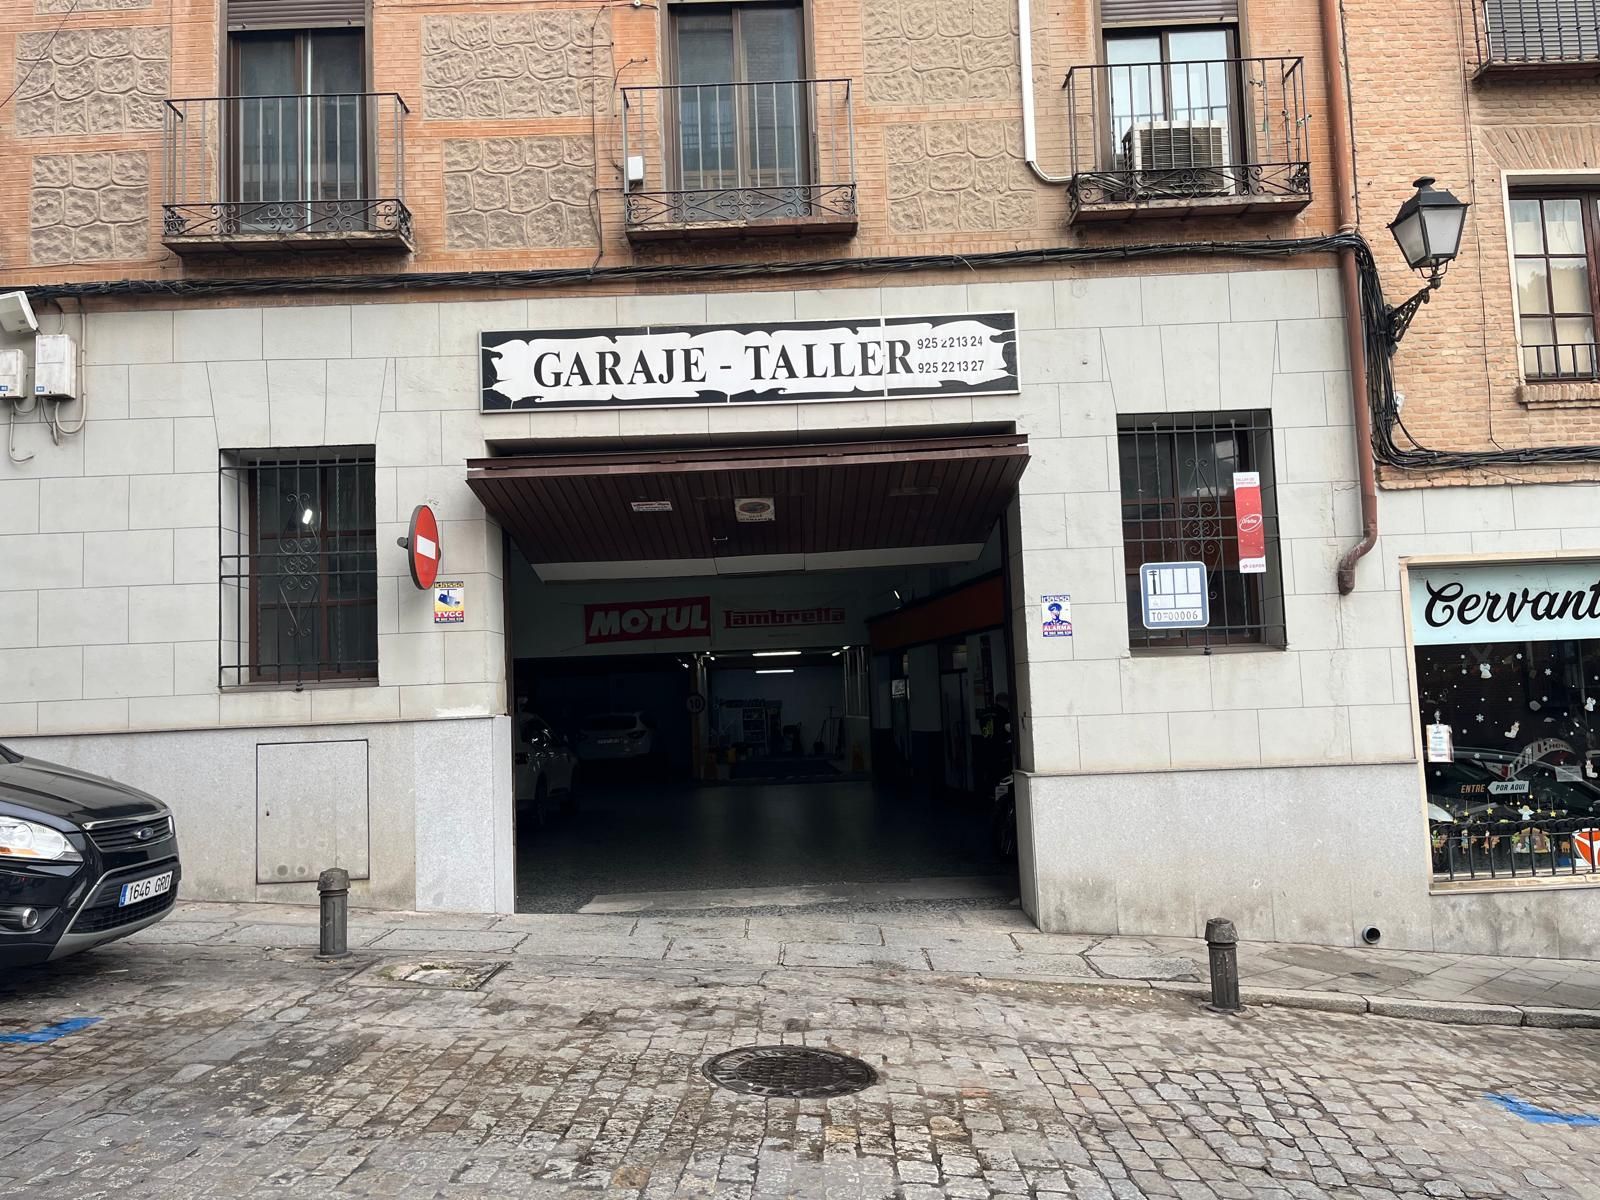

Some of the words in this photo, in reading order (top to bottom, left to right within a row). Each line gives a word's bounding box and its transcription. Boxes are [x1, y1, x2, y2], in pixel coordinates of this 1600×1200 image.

[917, 337, 938, 350] 925
[533, 347, 707, 388] GARAJE
[744, 339, 914, 381] TALLER
[918, 361, 939, 374] 925
[589, 604, 708, 636] MOTUL
[1460, 784, 1486, 793] ENTRE
[129, 880, 151, 902] 1646
